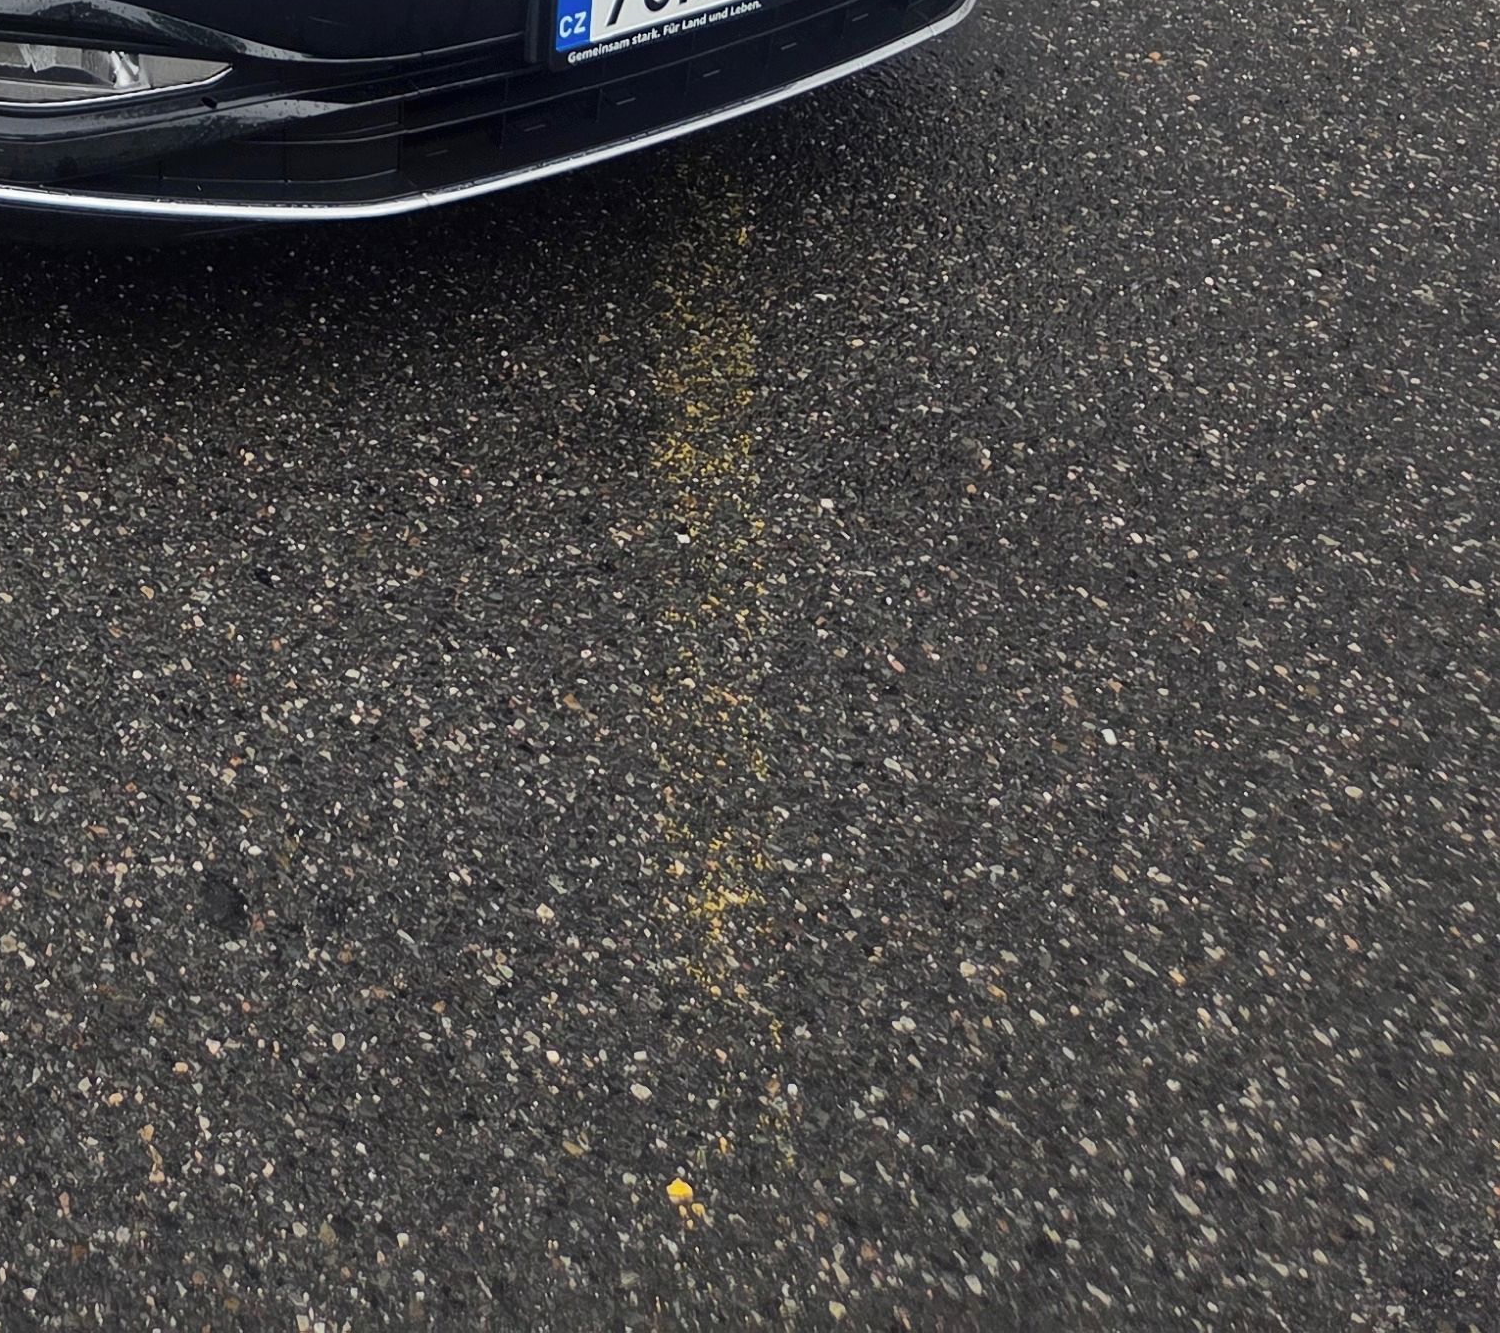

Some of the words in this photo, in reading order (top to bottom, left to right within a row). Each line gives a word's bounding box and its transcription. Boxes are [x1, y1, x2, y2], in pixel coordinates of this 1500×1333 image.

[559, 11, 587, 38] CZ
[567, 37, 630, 64] Gemeinsam
[632, 27, 661, 46] stark.
[663, 22, 680, 37] Für
[682, 14, 707, 31] Land
[708, 7, 728, 23] und
